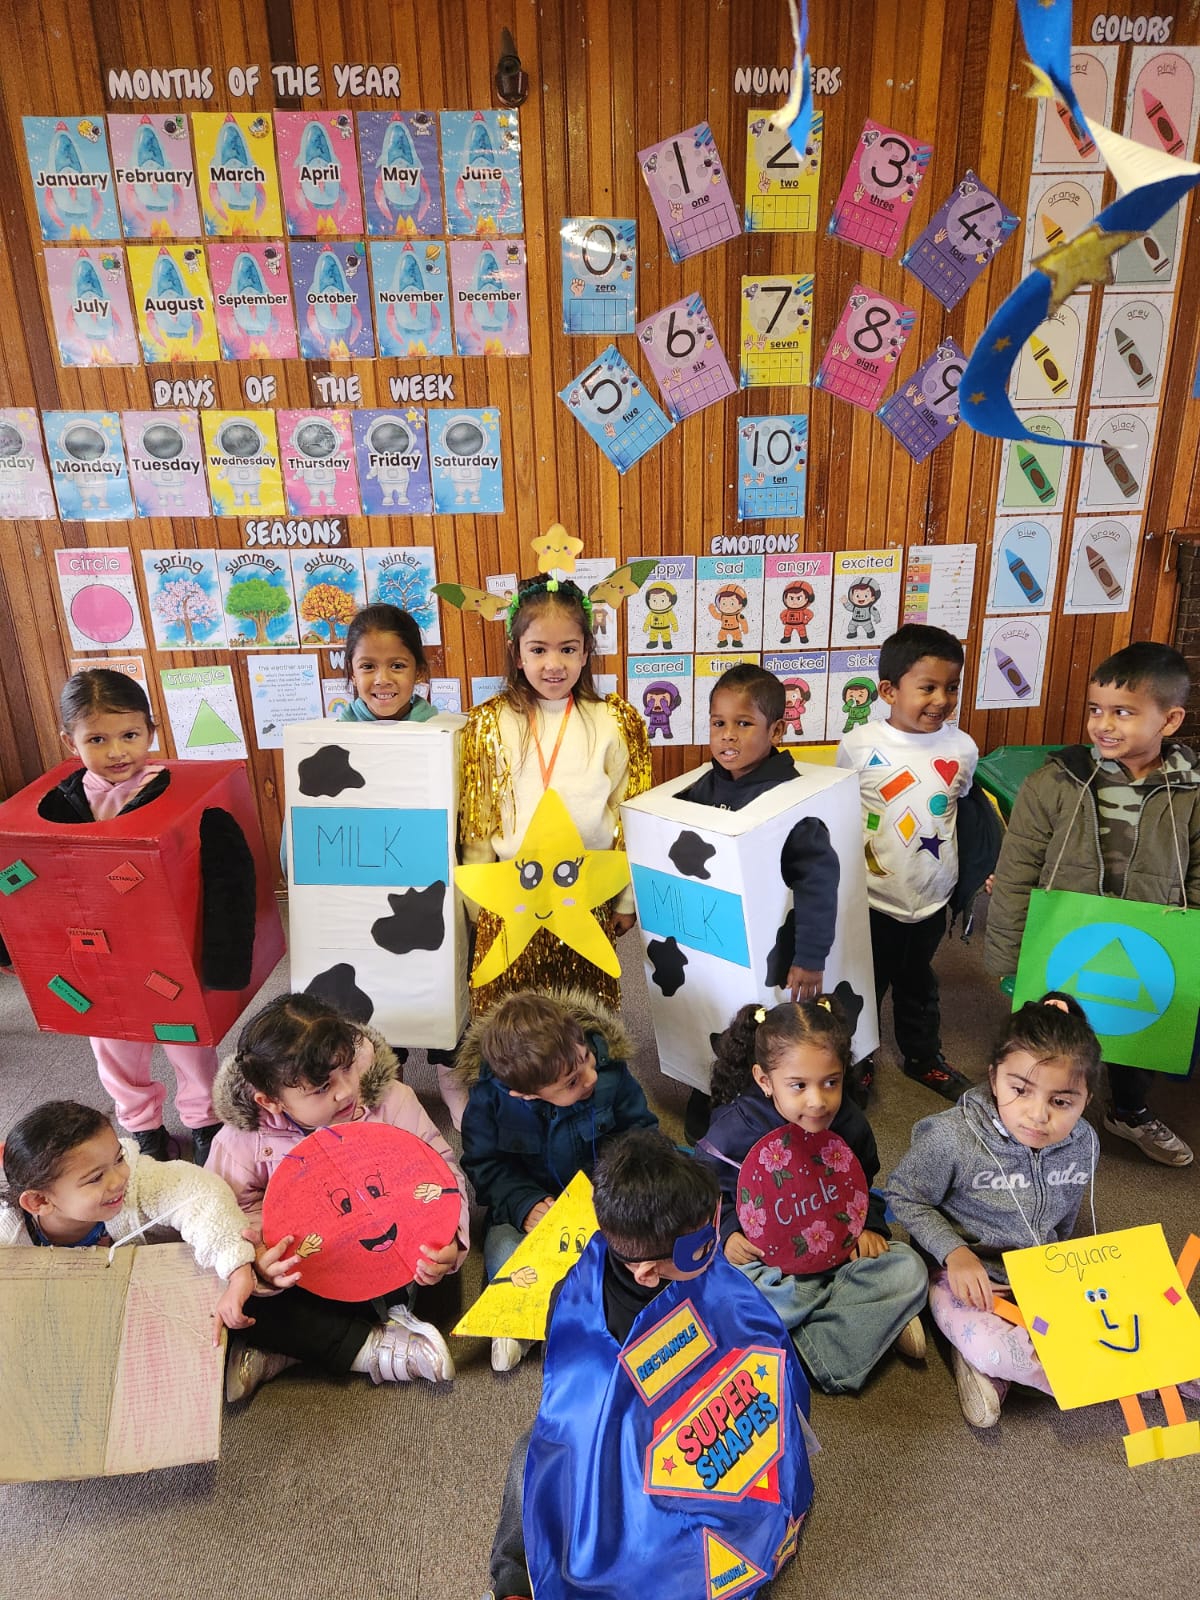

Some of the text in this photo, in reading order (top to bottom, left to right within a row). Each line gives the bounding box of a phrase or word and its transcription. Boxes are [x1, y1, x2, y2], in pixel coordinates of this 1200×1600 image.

[1091, 15, 1173, 43] COLORS
[108, 63, 401, 100] MONTHS OF THE YEAR
[734, 66, 841, 95] NUMRS
[871, 137, 910, 188] 3
[36, 172, 109, 191] January
[116, 168, 194, 189] February
[210, 166, 266, 182] March
[300, 165, 340, 187] April
[382, 167, 420, 185] May
[461, 166, 503, 182] June
[780, 179, 798, 188] two
[691, 194, 710, 209] one
[869, 194, 895, 213] three
[1047, 190, 1081, 206] orange
[958, 201, 995, 241] 4
[582, 224, 616, 276] 0
[950, 244, 968, 265] four
[458, 290, 522, 302] December
[595, 283, 617, 292] zero
[218, 293, 288, 309] September
[307, 292, 357, 304] October
[379, 291, 444, 303] November
[74, 299, 109, 317] July
[145, 297, 205, 316] August
[760, 286, 793, 333] 7
[1126, 309, 1150, 320] grey
[666, 311, 696, 358] 6
[853, 306, 891, 353] 8
[770, 340, 799, 348] seven
[692, 359, 706, 371] six
[856, 357, 881, 374] eight
[154, 374, 455, 407] DAYS OF THE WEEK
[580, 364, 623, 415] 5
[933, 364, 964, 407] 9
[621, 406, 640, 423] five
[921, 407, 939, 427] nine
[1028, 424, 1051, 433] reen
[1111, 420, 1137, 433] black
[752, 429, 792, 466] 10
[56, 459, 122, 476] Monday
[132, 457, 200, 475] Tuesday
[210, 455, 276, 467] Wednesday
[288, 457, 350, 470] Thursday
[369, 453, 421, 471] Friday
[434, 454, 498, 470] Saturday
[772, 474, 788, 483] ten
[246, 519, 342, 546] SEASONS
[1017, 527, 1037, 537] blue
[1091, 529, 1121, 541] brown
[711, 533, 799, 555] EMOTIONS
[69, 555, 121, 572] circle
[153, 552, 204, 575] spring
[224, 553, 282, 574] summer
[303, 551, 356, 574] autumn
[377, 551, 422, 568] winter
[715, 561, 745, 575] Sad
[777, 559, 821, 576] angry
[841, 555, 894, 570] excited
[652, 563, 686, 579] ppy
[1002, 629, 1030, 641] purple
[635, 659, 685, 673] scared
[766, 656, 825, 671] shocked
[848, 654, 876, 667] Sick
[166, 666, 226, 686] triangle
[317, 825, 403, 868] MILK
[651, 879, 724, 947] MILK
[972, 1170, 1031, 1190] Can
[774, 1177, 839, 1225] Circle
[1045, 1245, 1122, 1281] Square
[635, 1323, 699, 1382] RECTANGLE
[676, 1370, 760, 1465] SUPER
[696, 1392, 778, 1490] SHAPES
[711, 1560, 748, 1590] TRIANGLE
